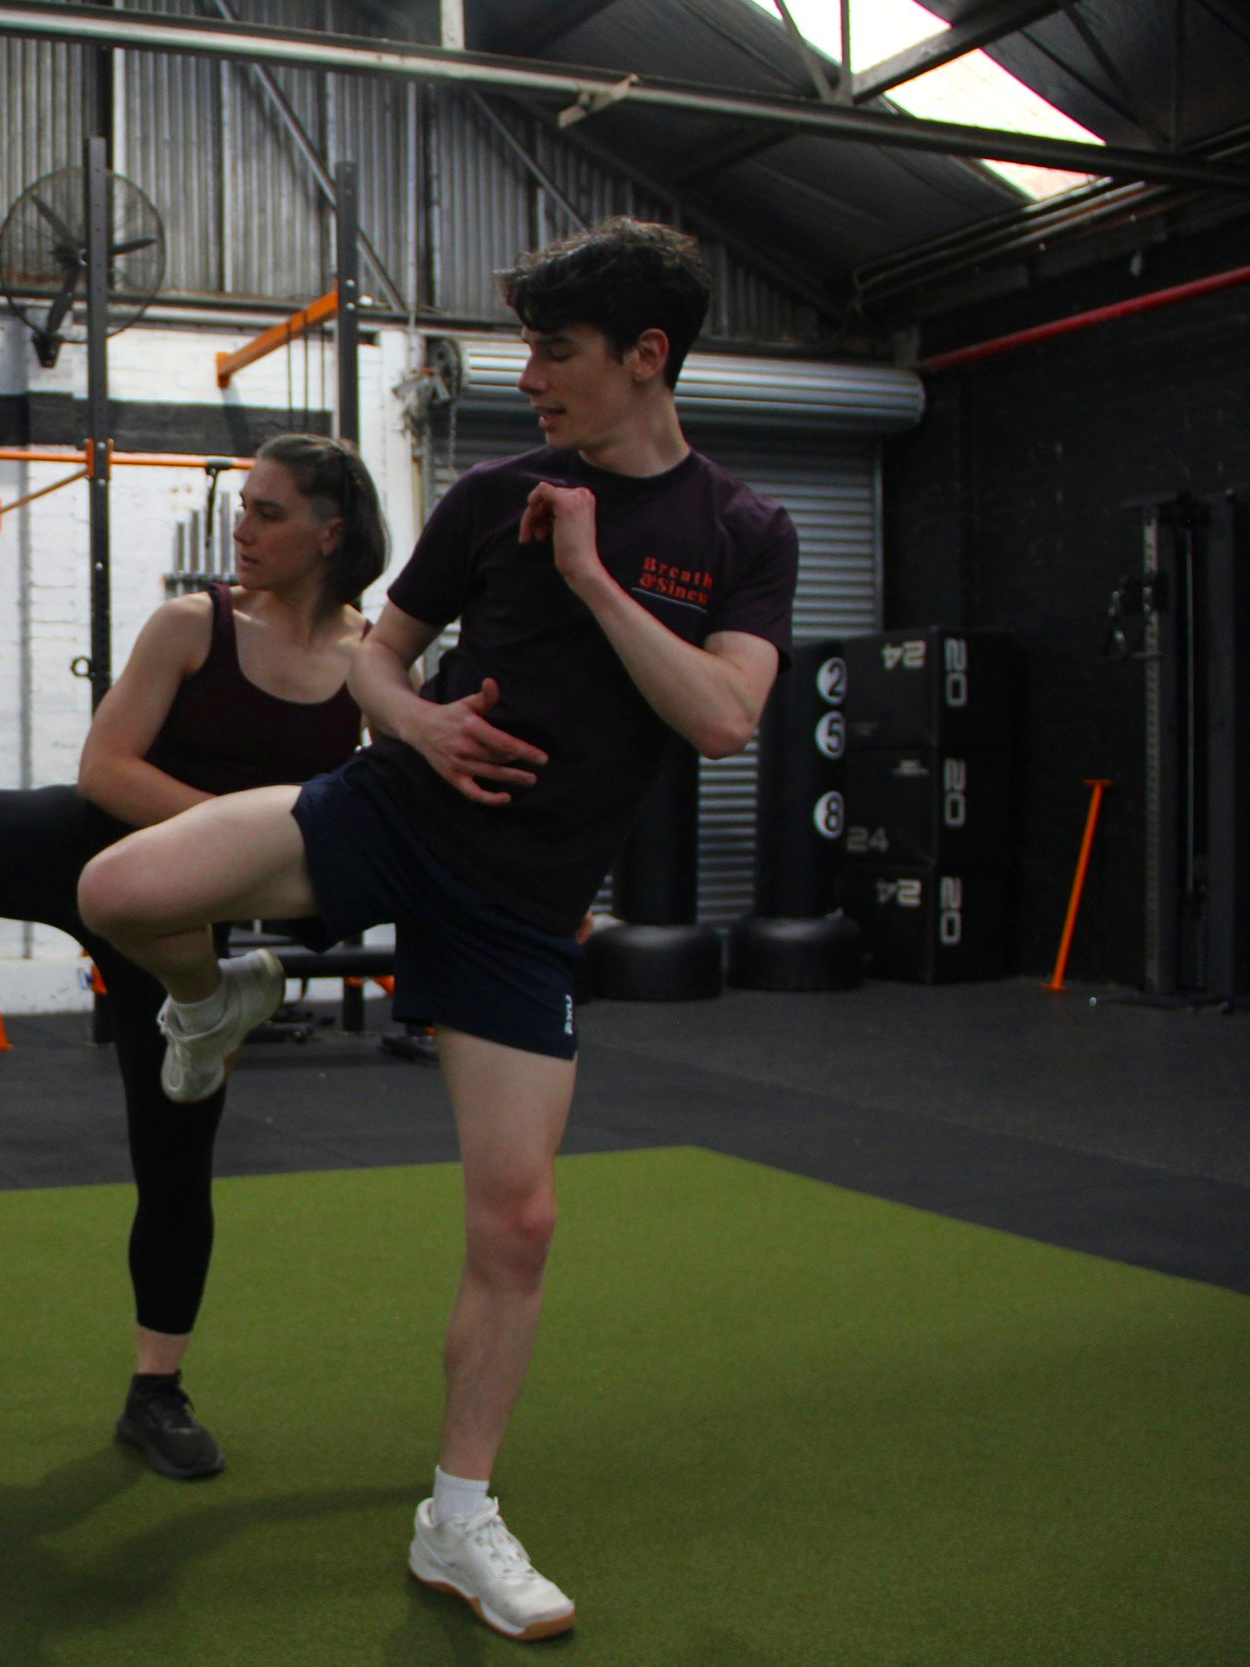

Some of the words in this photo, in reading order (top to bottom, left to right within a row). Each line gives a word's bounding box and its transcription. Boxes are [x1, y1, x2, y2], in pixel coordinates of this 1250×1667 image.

[643, 556, 713, 590] Breath
[881, 641, 927, 670] 24
[944, 637, 968, 708] 20
[943, 757, 966, 828] 20
[847, 826, 890, 853] 24
[876, 876, 922, 907] 24
[940, 875, 962, 945] 20
